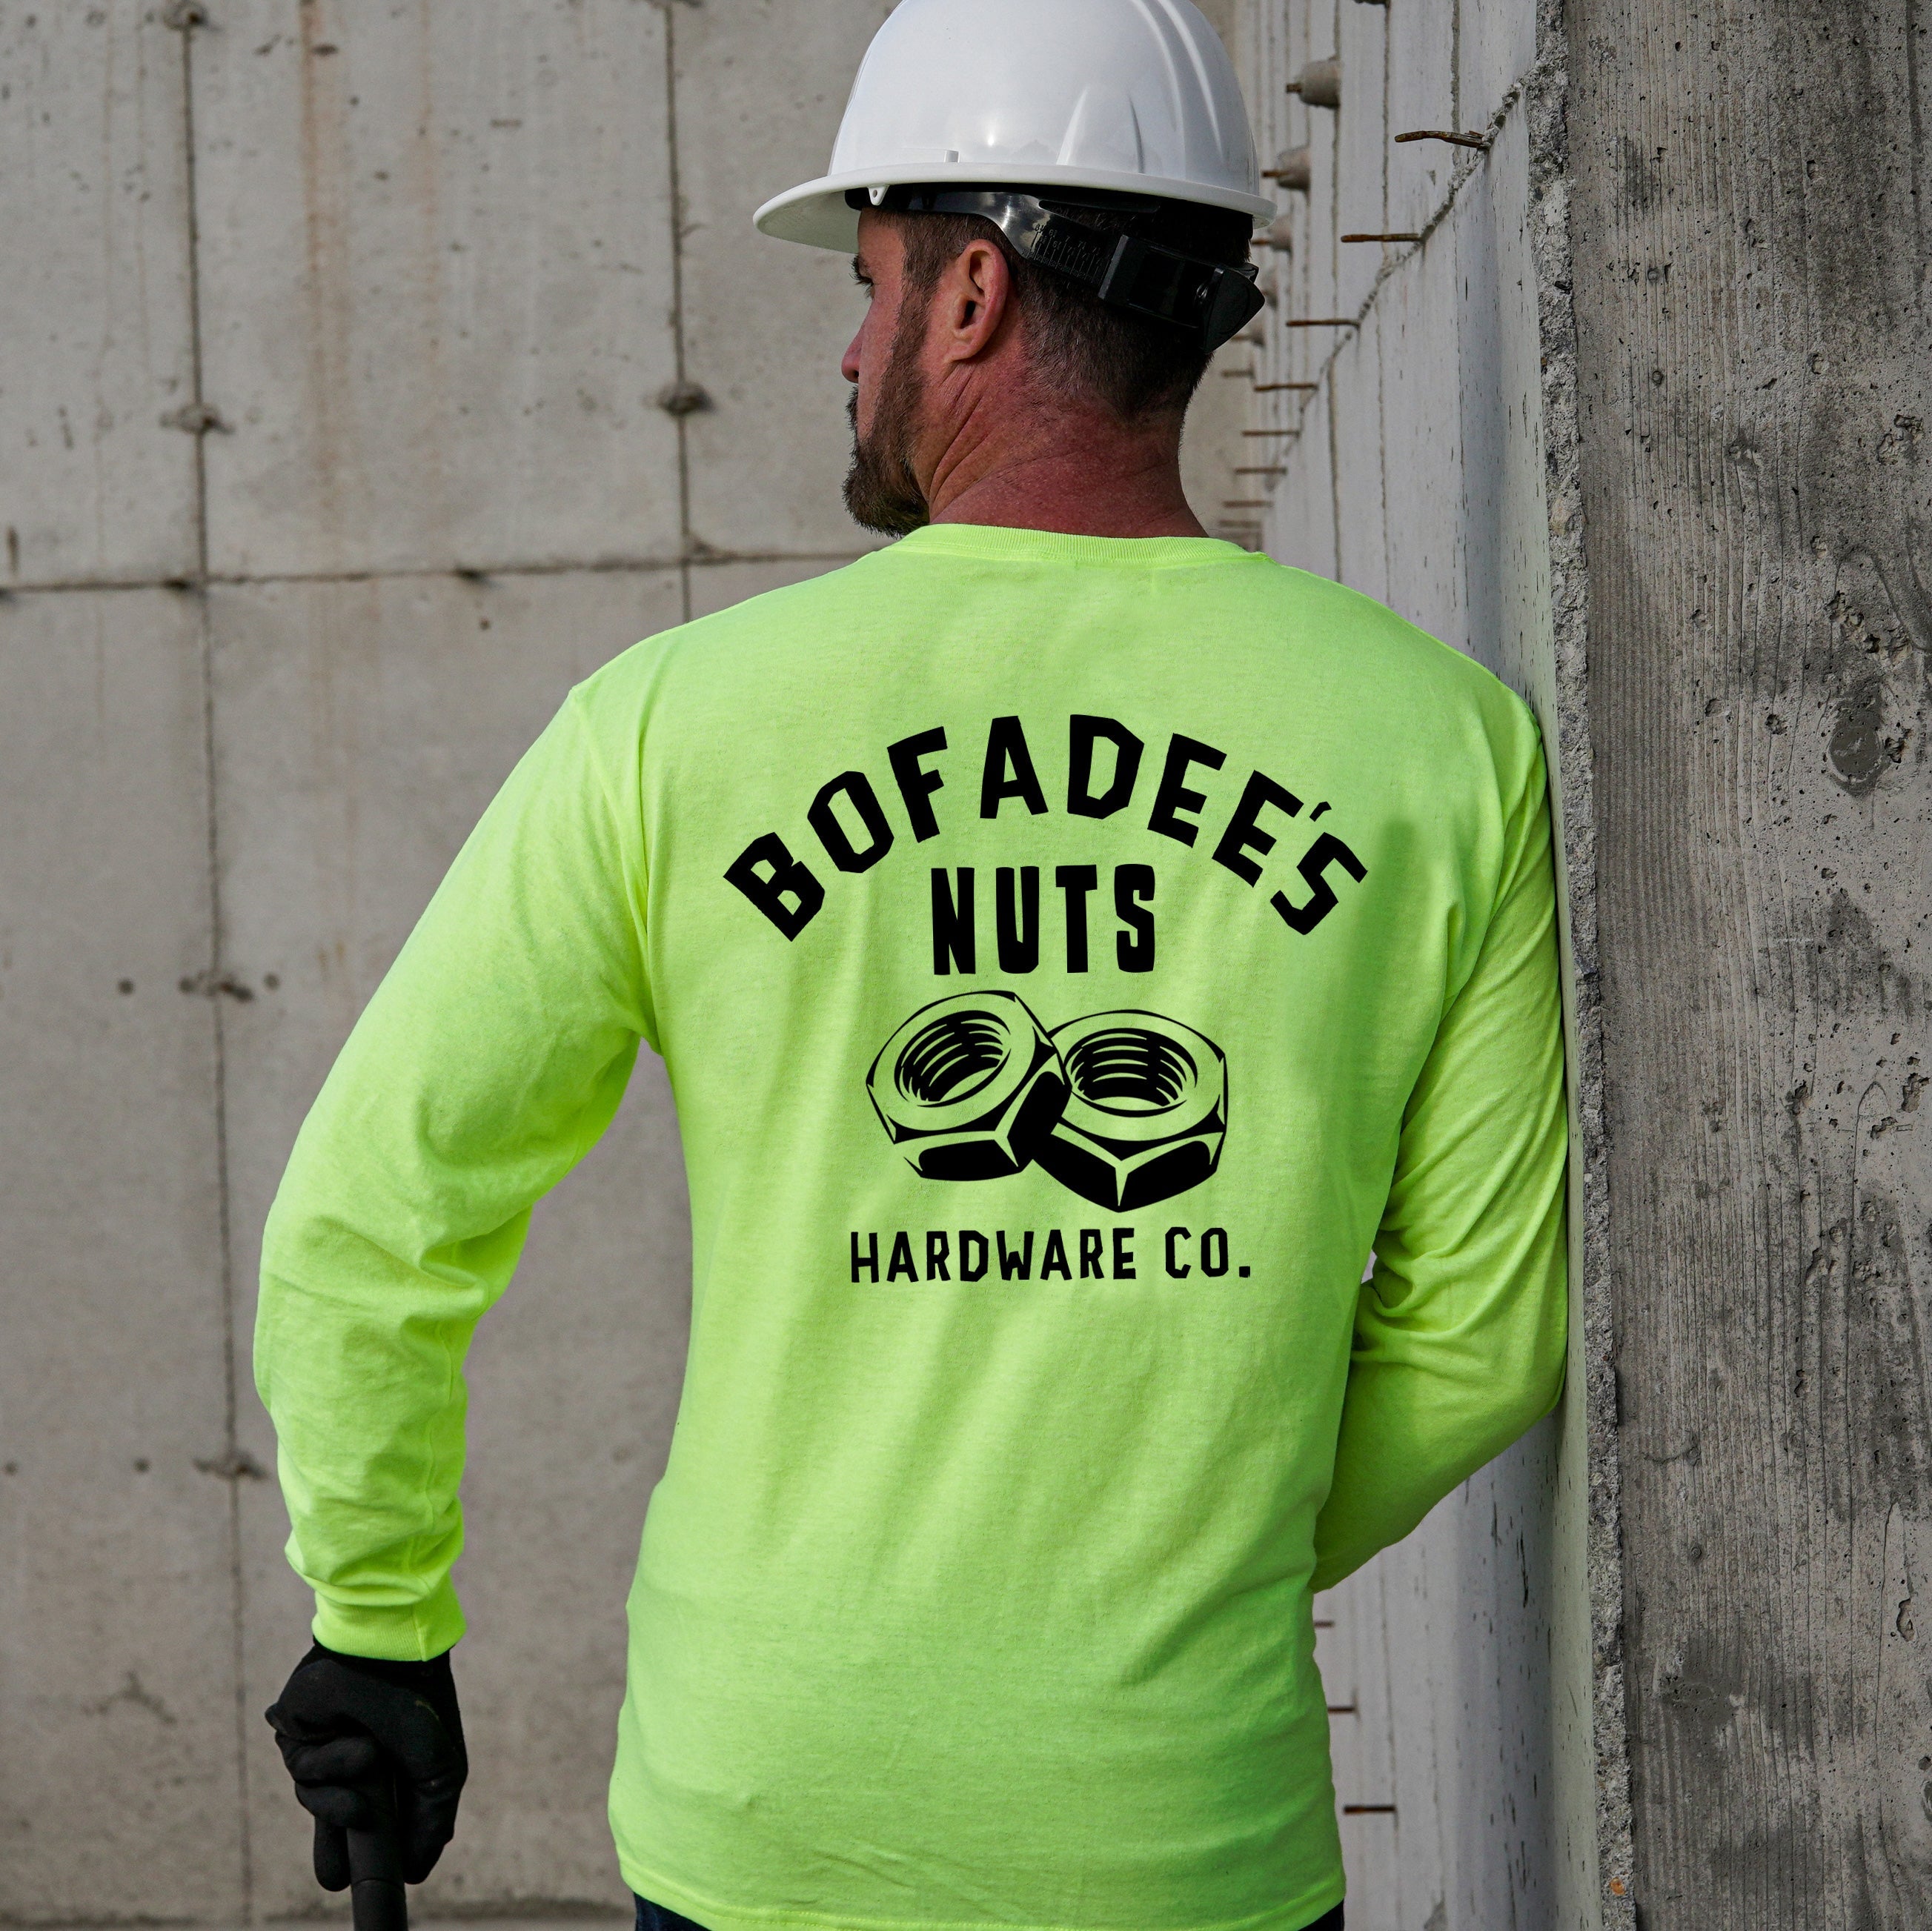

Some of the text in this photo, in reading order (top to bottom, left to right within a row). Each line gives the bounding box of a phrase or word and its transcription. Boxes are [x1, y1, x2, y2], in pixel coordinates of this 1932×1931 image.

[723, 714, 1368, 942] BOFADEE'S
[931, 863, 1155, 976] NUTS
[851, 1226, 1251, 1283] HARDWARE CO.
